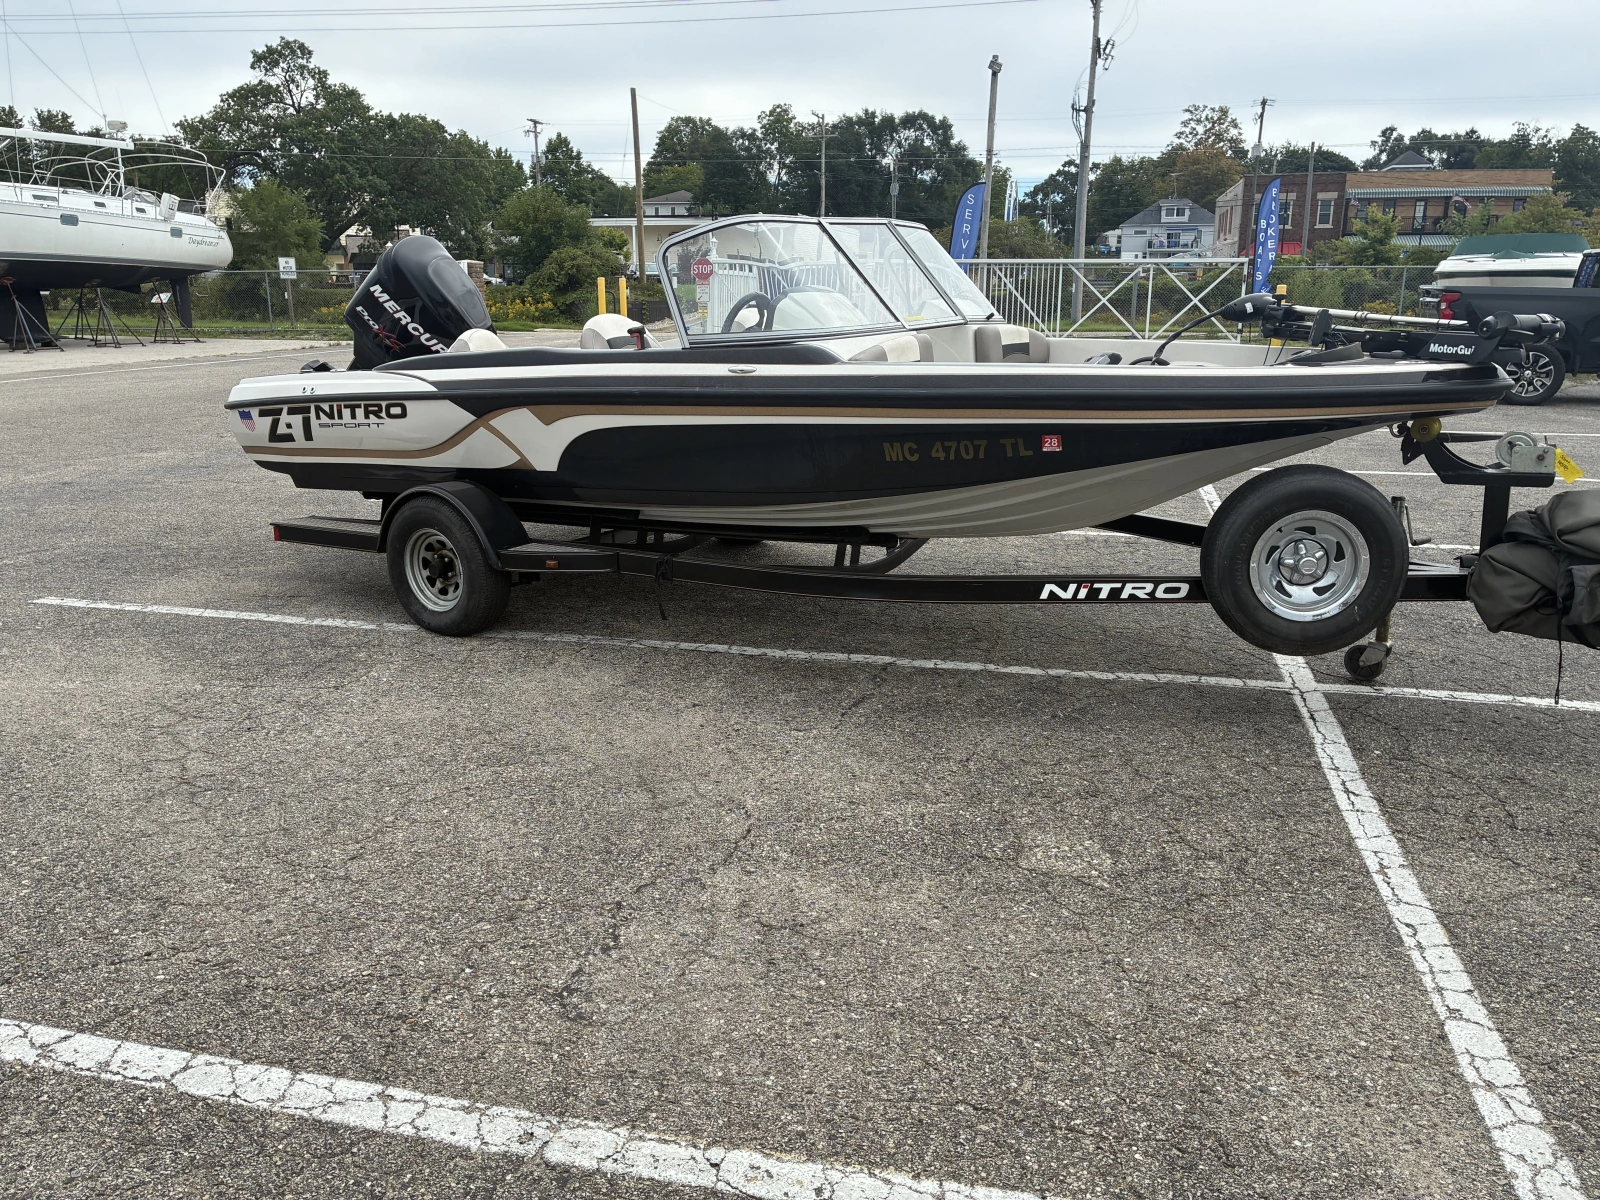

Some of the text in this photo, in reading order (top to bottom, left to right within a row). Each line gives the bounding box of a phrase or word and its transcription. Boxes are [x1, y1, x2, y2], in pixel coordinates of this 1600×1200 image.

[1255, 219, 1267, 281] BOATS
[694, 265, 712, 273] STOP
[883, 438, 1034, 462] MC 4707 TL
[1044, 438, 1058, 447] 28
